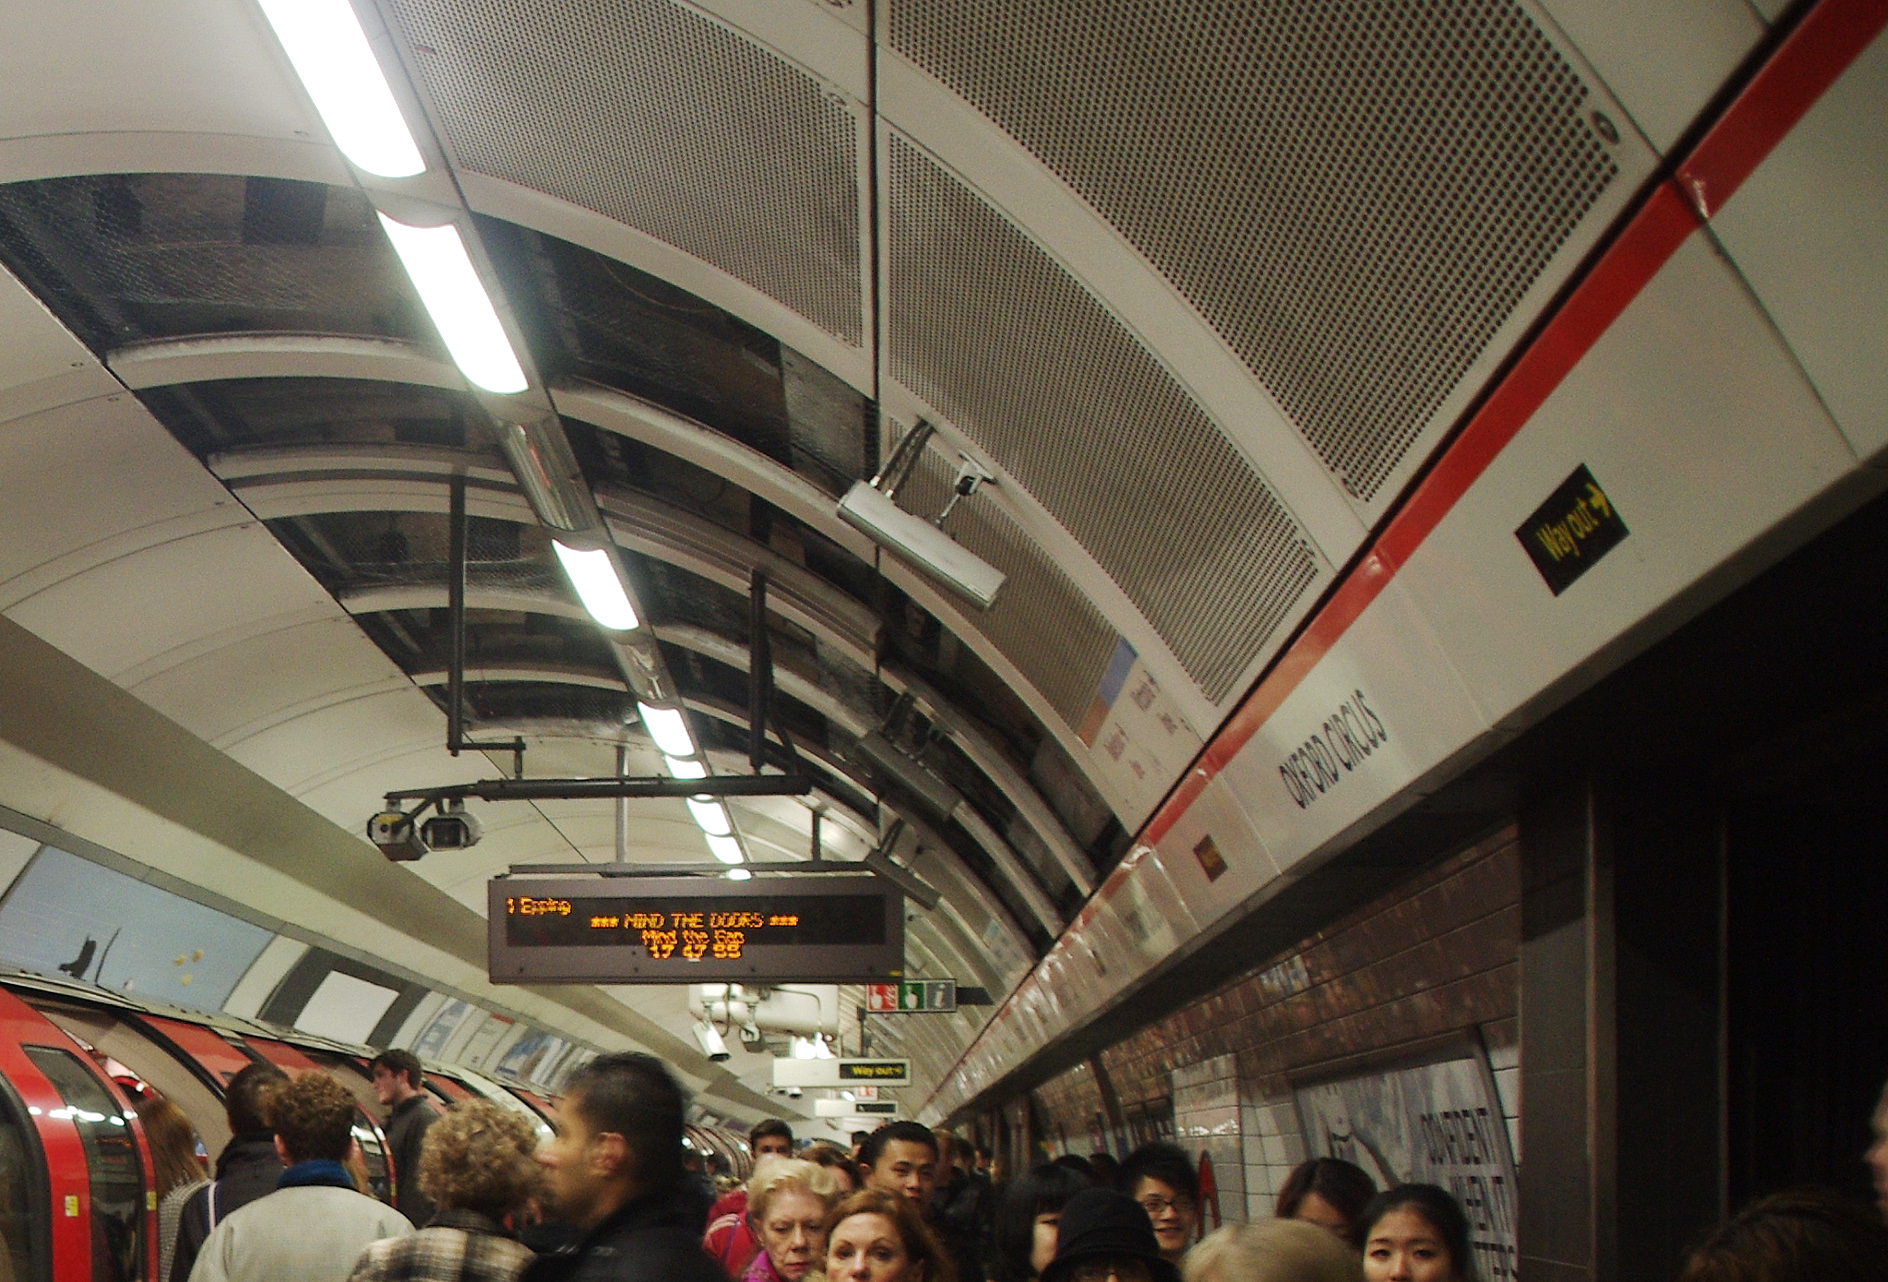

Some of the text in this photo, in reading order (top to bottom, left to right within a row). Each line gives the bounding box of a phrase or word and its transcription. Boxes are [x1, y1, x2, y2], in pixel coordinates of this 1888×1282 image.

[1536, 497, 1600, 561] Way out
[1279, 689, 1387, 809] OXFORD CIRCUS
[519, 897, 572, 915] Epping
[623, 912, 764, 929] MIND THE DOORS
[641, 929, 746, 946] Mind the Gap
[852, 1066, 894, 1077] Way out
